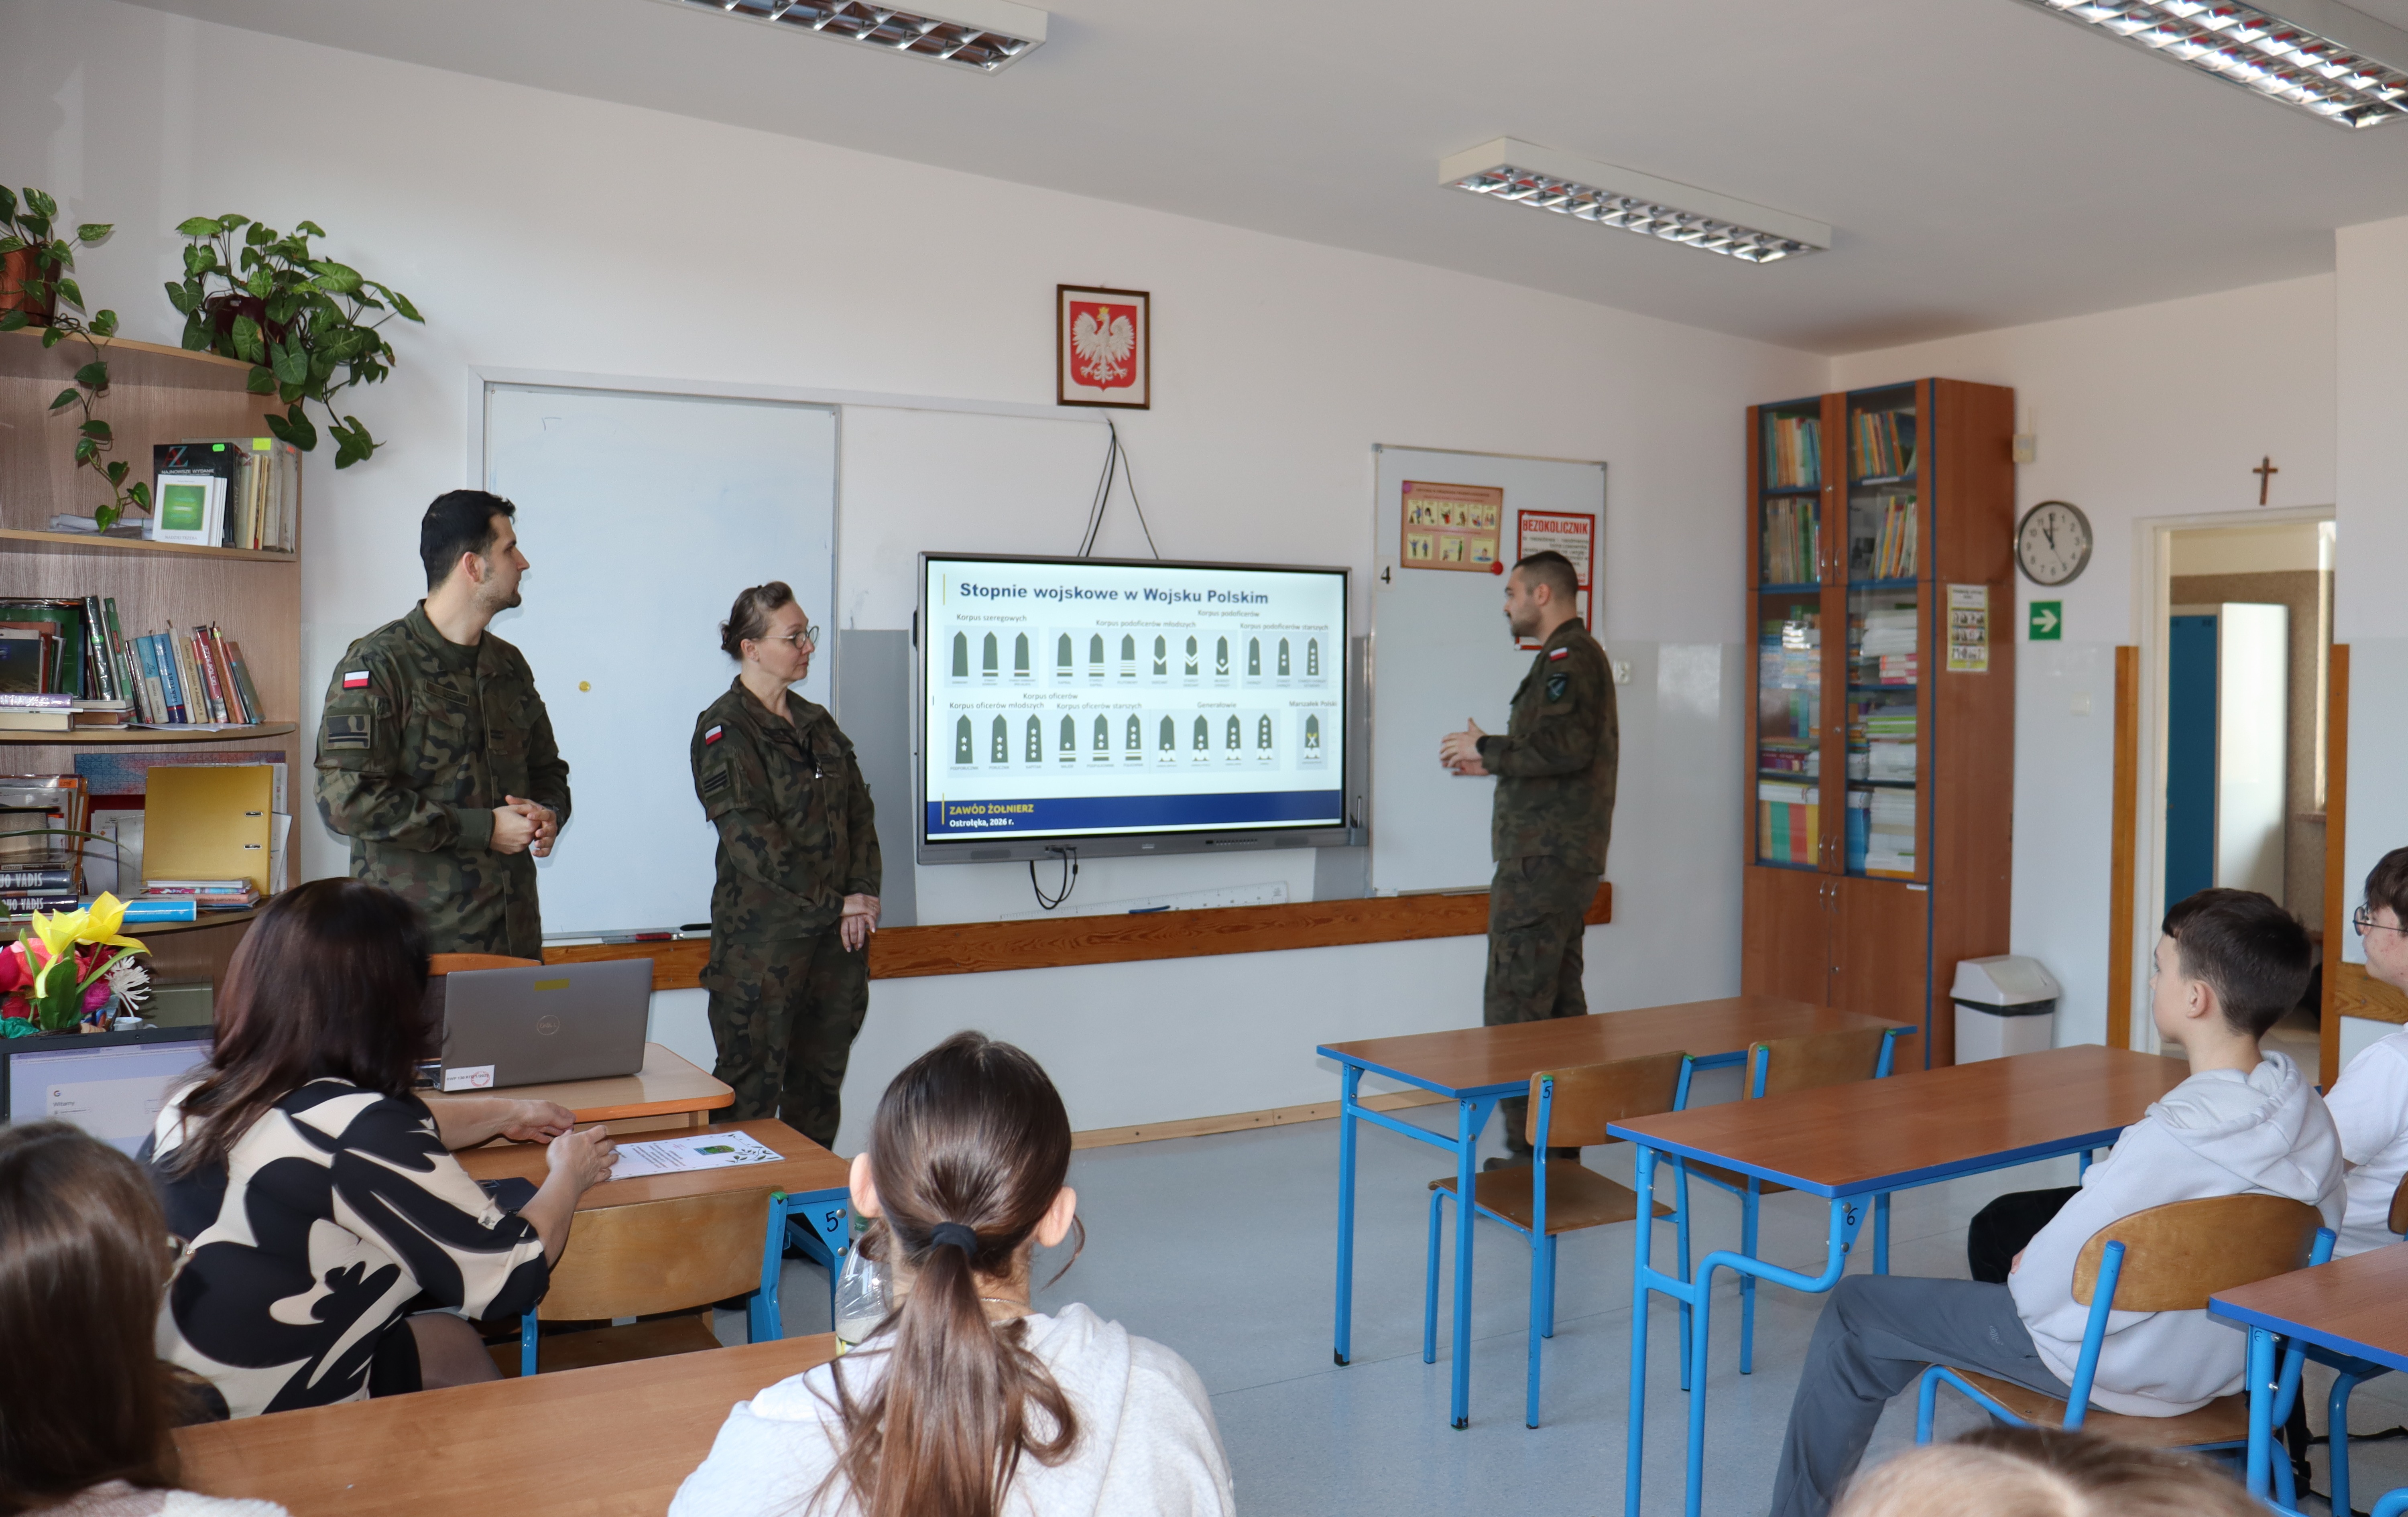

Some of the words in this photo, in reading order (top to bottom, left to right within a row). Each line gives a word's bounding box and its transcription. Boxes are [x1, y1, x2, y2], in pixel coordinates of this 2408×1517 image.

[1523, 520, 1588, 534] BEZOKOLICZNIK
[1381, 565, 1390, 584] 4
[960, 583, 1027, 600] Stopnie
[1034, 586, 1118, 602] wojskowe
[1125, 591, 1138, 600] w
[1144, 588, 1201, 604] Wojsku
[1208, 590, 1268, 604] Polskim
[207, 663, 217, 686] POLSKI
[950, 803, 986, 815] ZAWÓD
[988, 803, 1034, 813] ŻOŁNIERZ
[950, 818, 988, 828] Ostrołęka,
[990, 818, 1007, 826] 2026
[16, 872, 43, 887] VADIS
[21, 897, 44, 911] VADIS
[1543, 1086, 1552, 1098] 5
[1461, 1100, 1466, 1111] 5
[826, 1210, 838, 1232] 5
[1847, 1207, 1858, 1226] 6
